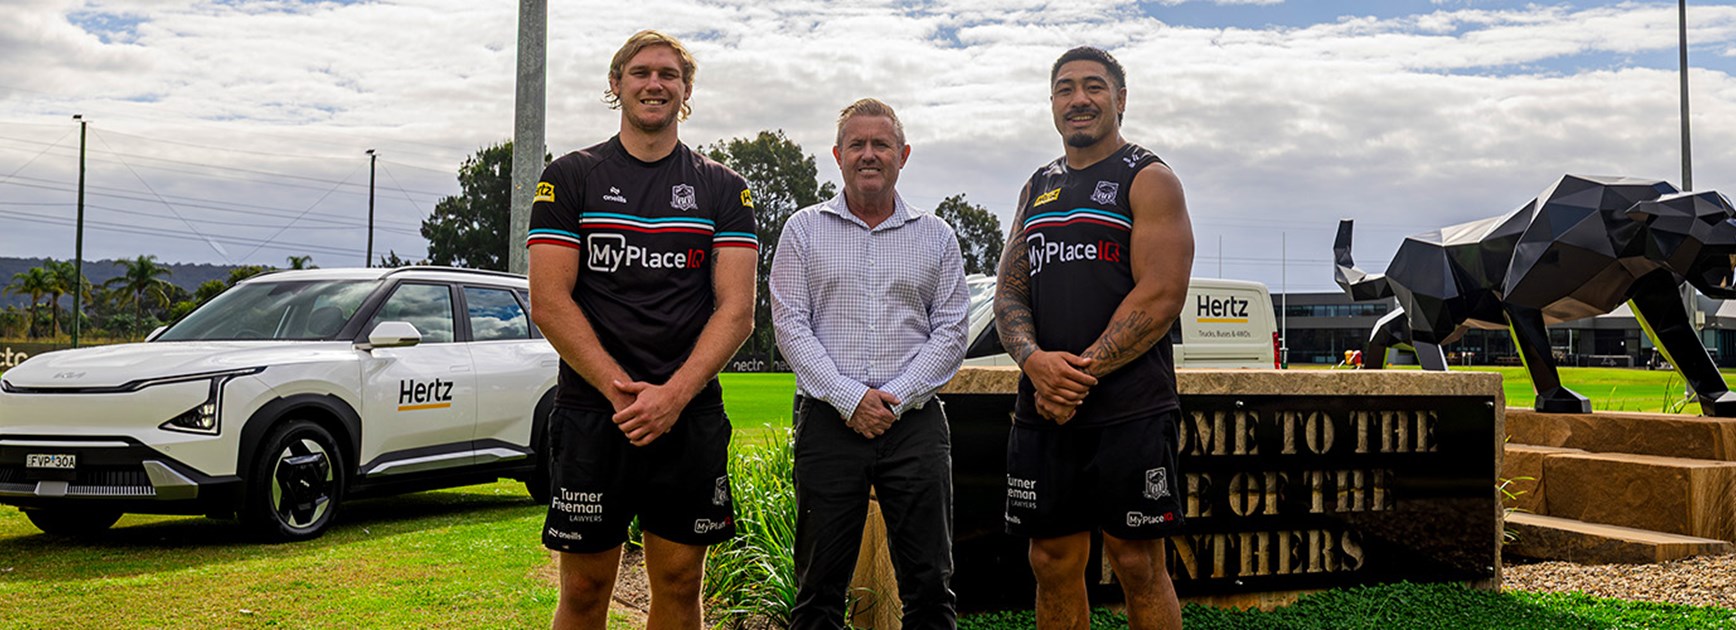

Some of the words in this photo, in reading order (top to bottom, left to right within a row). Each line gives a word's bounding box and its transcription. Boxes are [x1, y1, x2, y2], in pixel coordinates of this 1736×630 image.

[592, 243, 705, 272] MyPlaceIQ
[1028, 240, 1120, 272] MyPlaceIQ
[1197, 295, 1249, 317] Hertz
[733, 358, 764, 371] nectr
[399, 378, 453, 404] Hertz
[1275, 411, 1335, 455] TO
[1350, 410, 1438, 453] THE
[560, 487, 603, 502] Turner
[1007, 474, 1037, 489] urner
[1228, 471, 1289, 517] OF
[1303, 468, 1394, 513] THE
